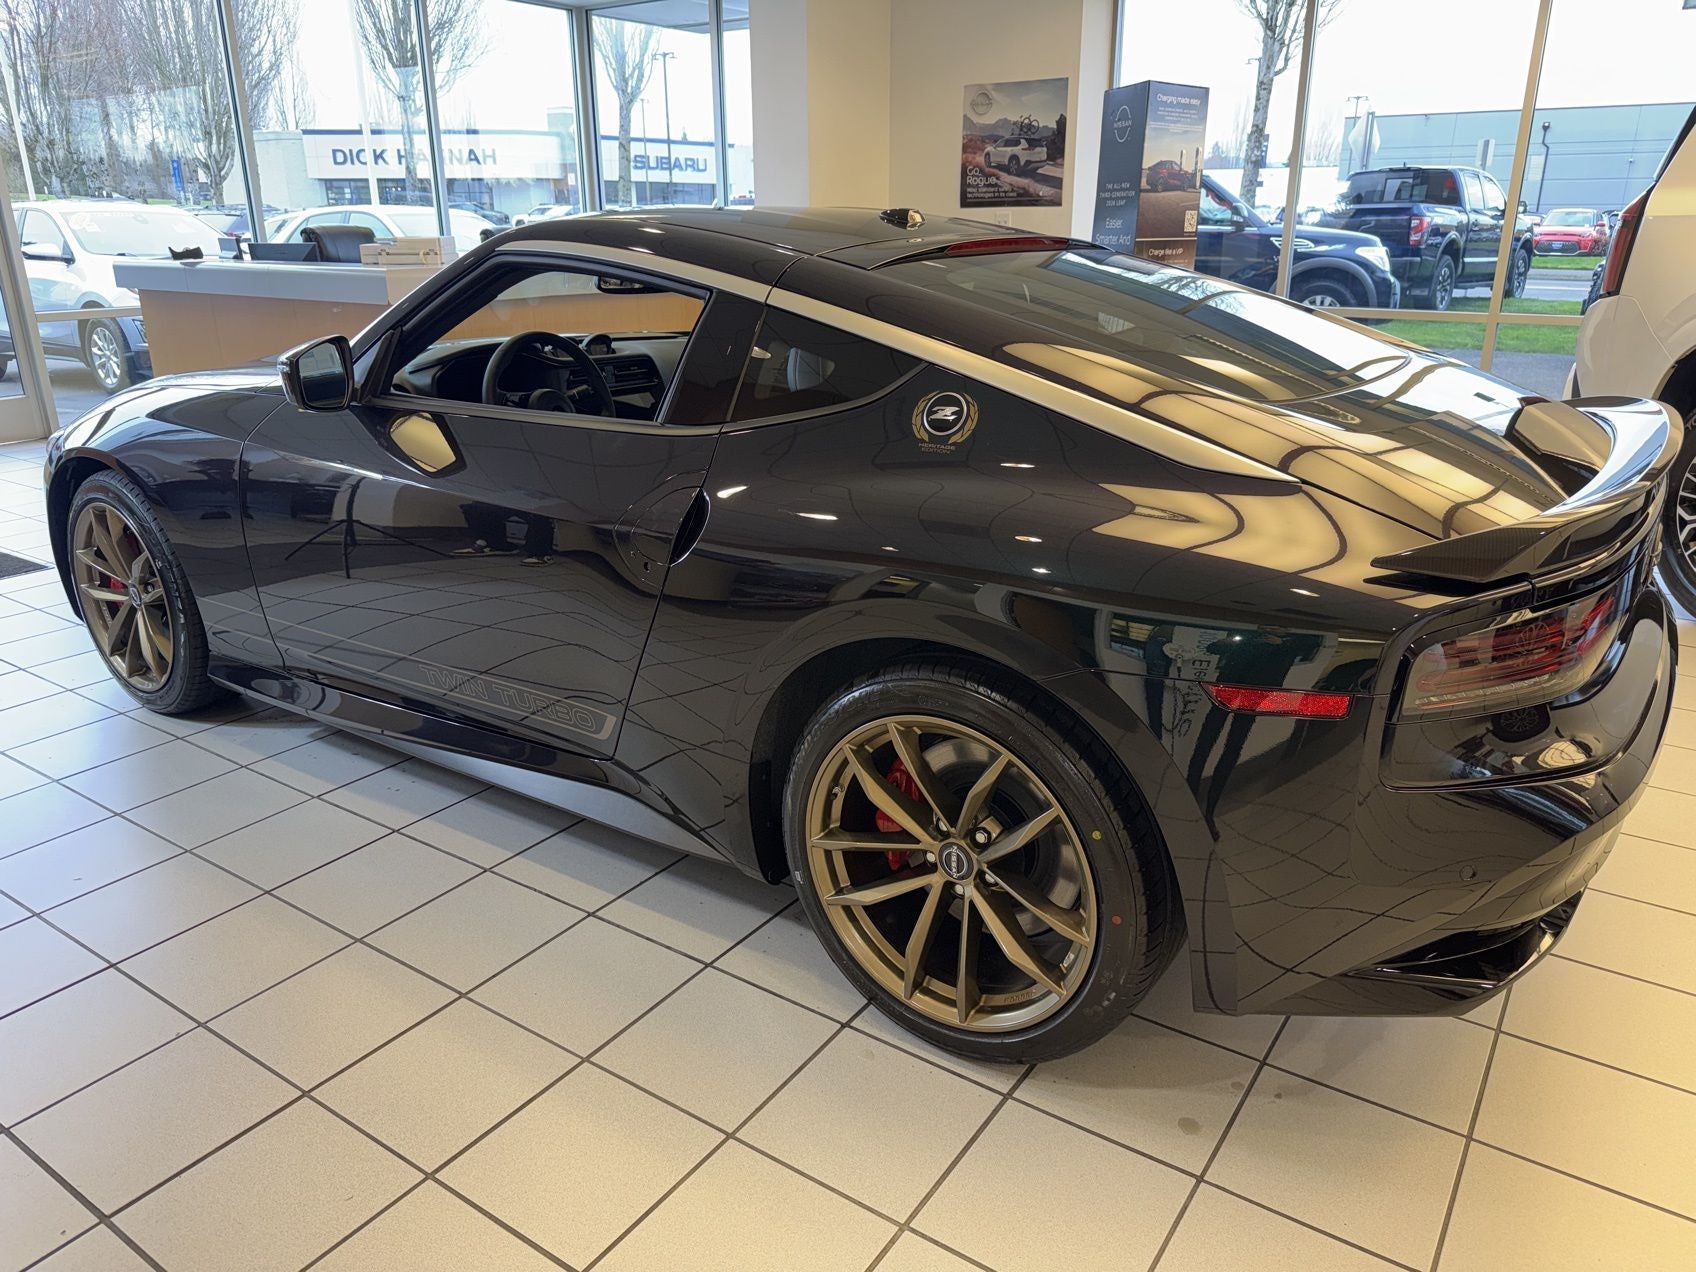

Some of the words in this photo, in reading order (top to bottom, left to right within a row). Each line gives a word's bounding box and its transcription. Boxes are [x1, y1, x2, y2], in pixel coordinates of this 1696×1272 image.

[632, 154, 708, 173] SUBARU
[918, 442, 956, 450] HERITAGE
[418, 664, 489, 700] TWIN
[492, 684, 596, 732] TURBO
